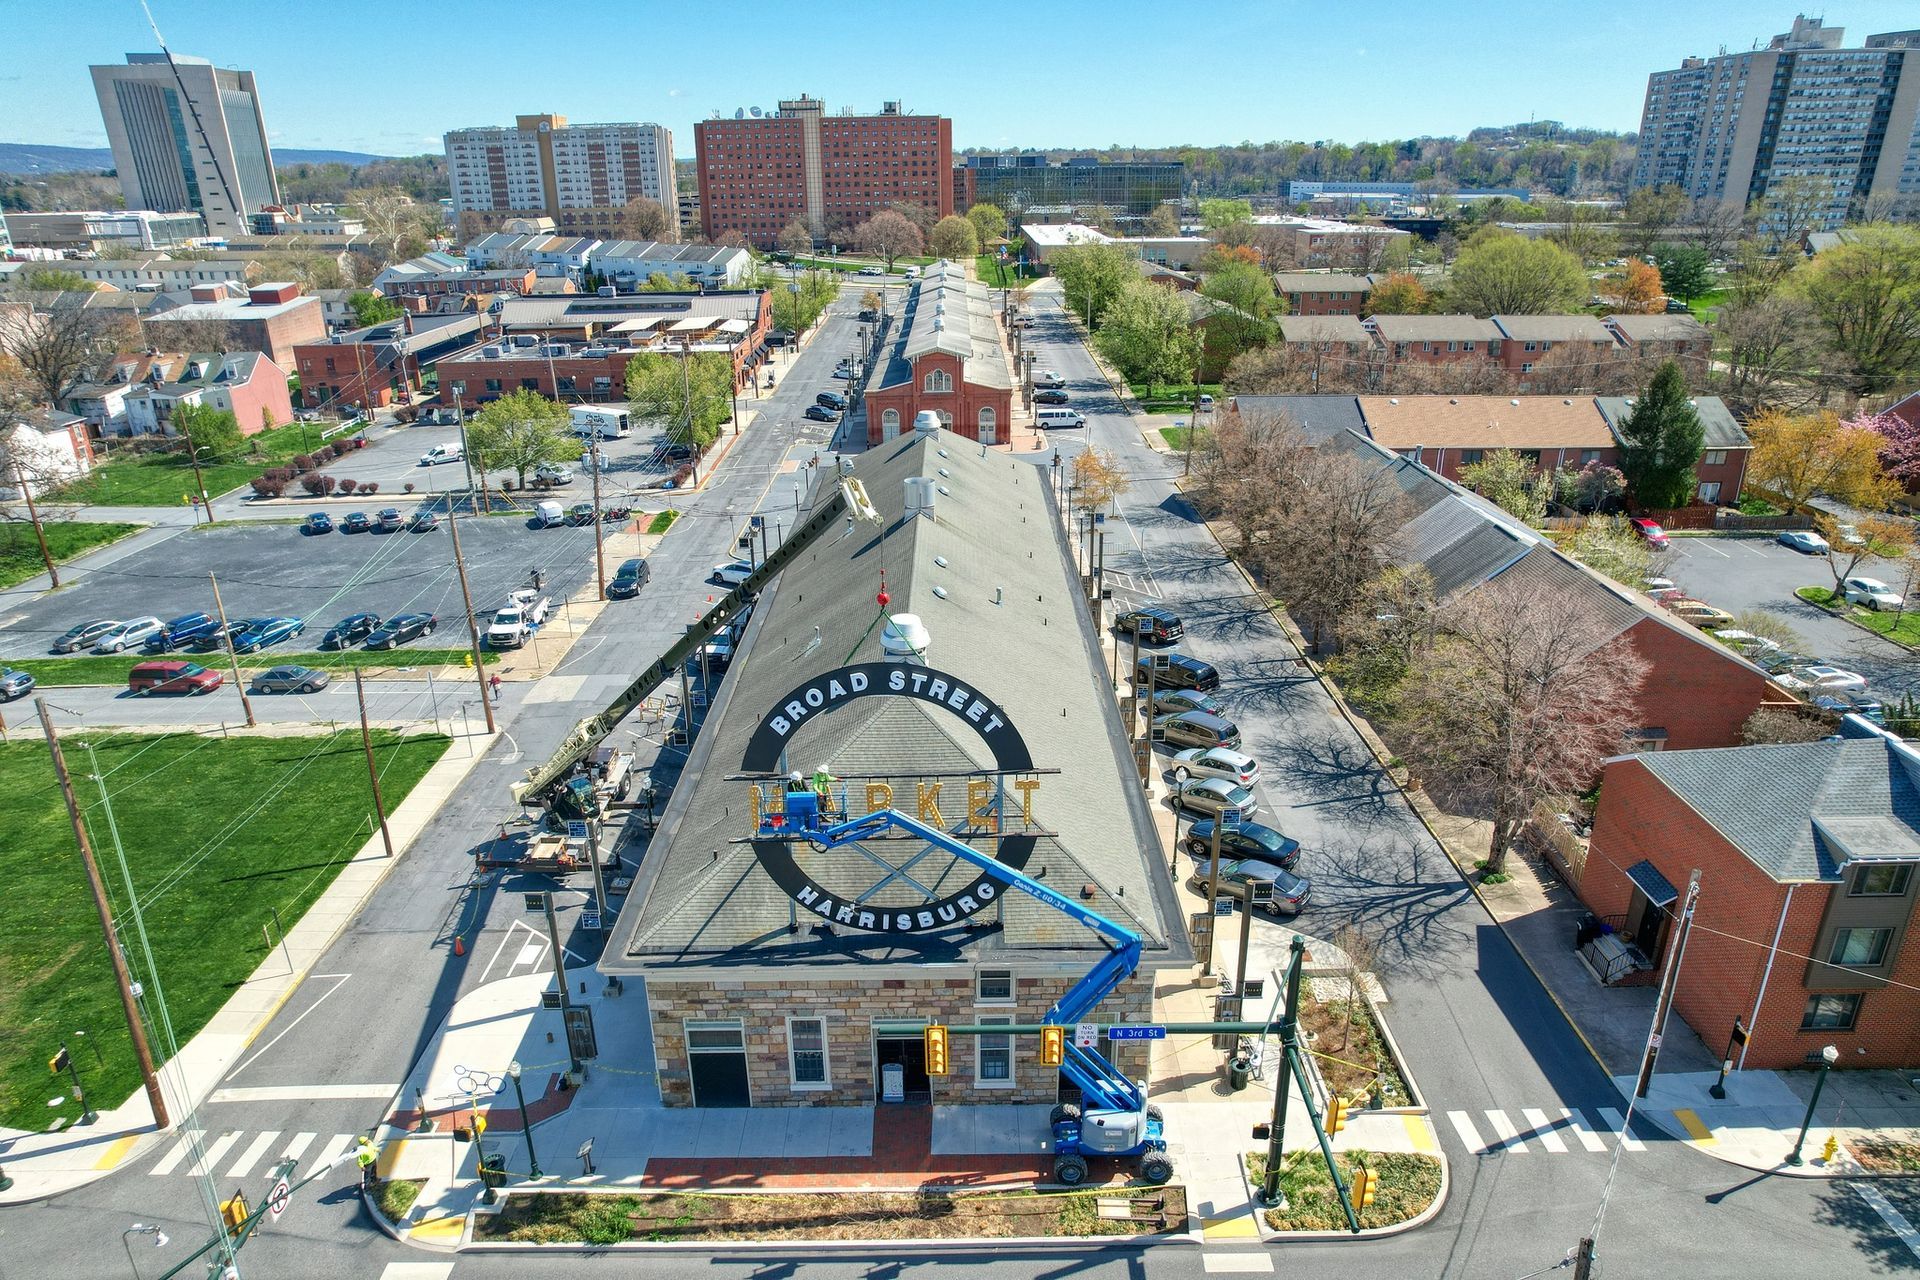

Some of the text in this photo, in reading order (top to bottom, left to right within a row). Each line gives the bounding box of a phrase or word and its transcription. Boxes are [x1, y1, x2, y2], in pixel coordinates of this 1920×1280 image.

[769, 670, 1004, 737] BROAD STREET
[750, 780, 1040, 831] MRKET
[796, 883, 995, 930] HARRISBURG
[1128, 1029, 1143, 1038] 3rd
[1148, 1029, 1158, 1037] St
